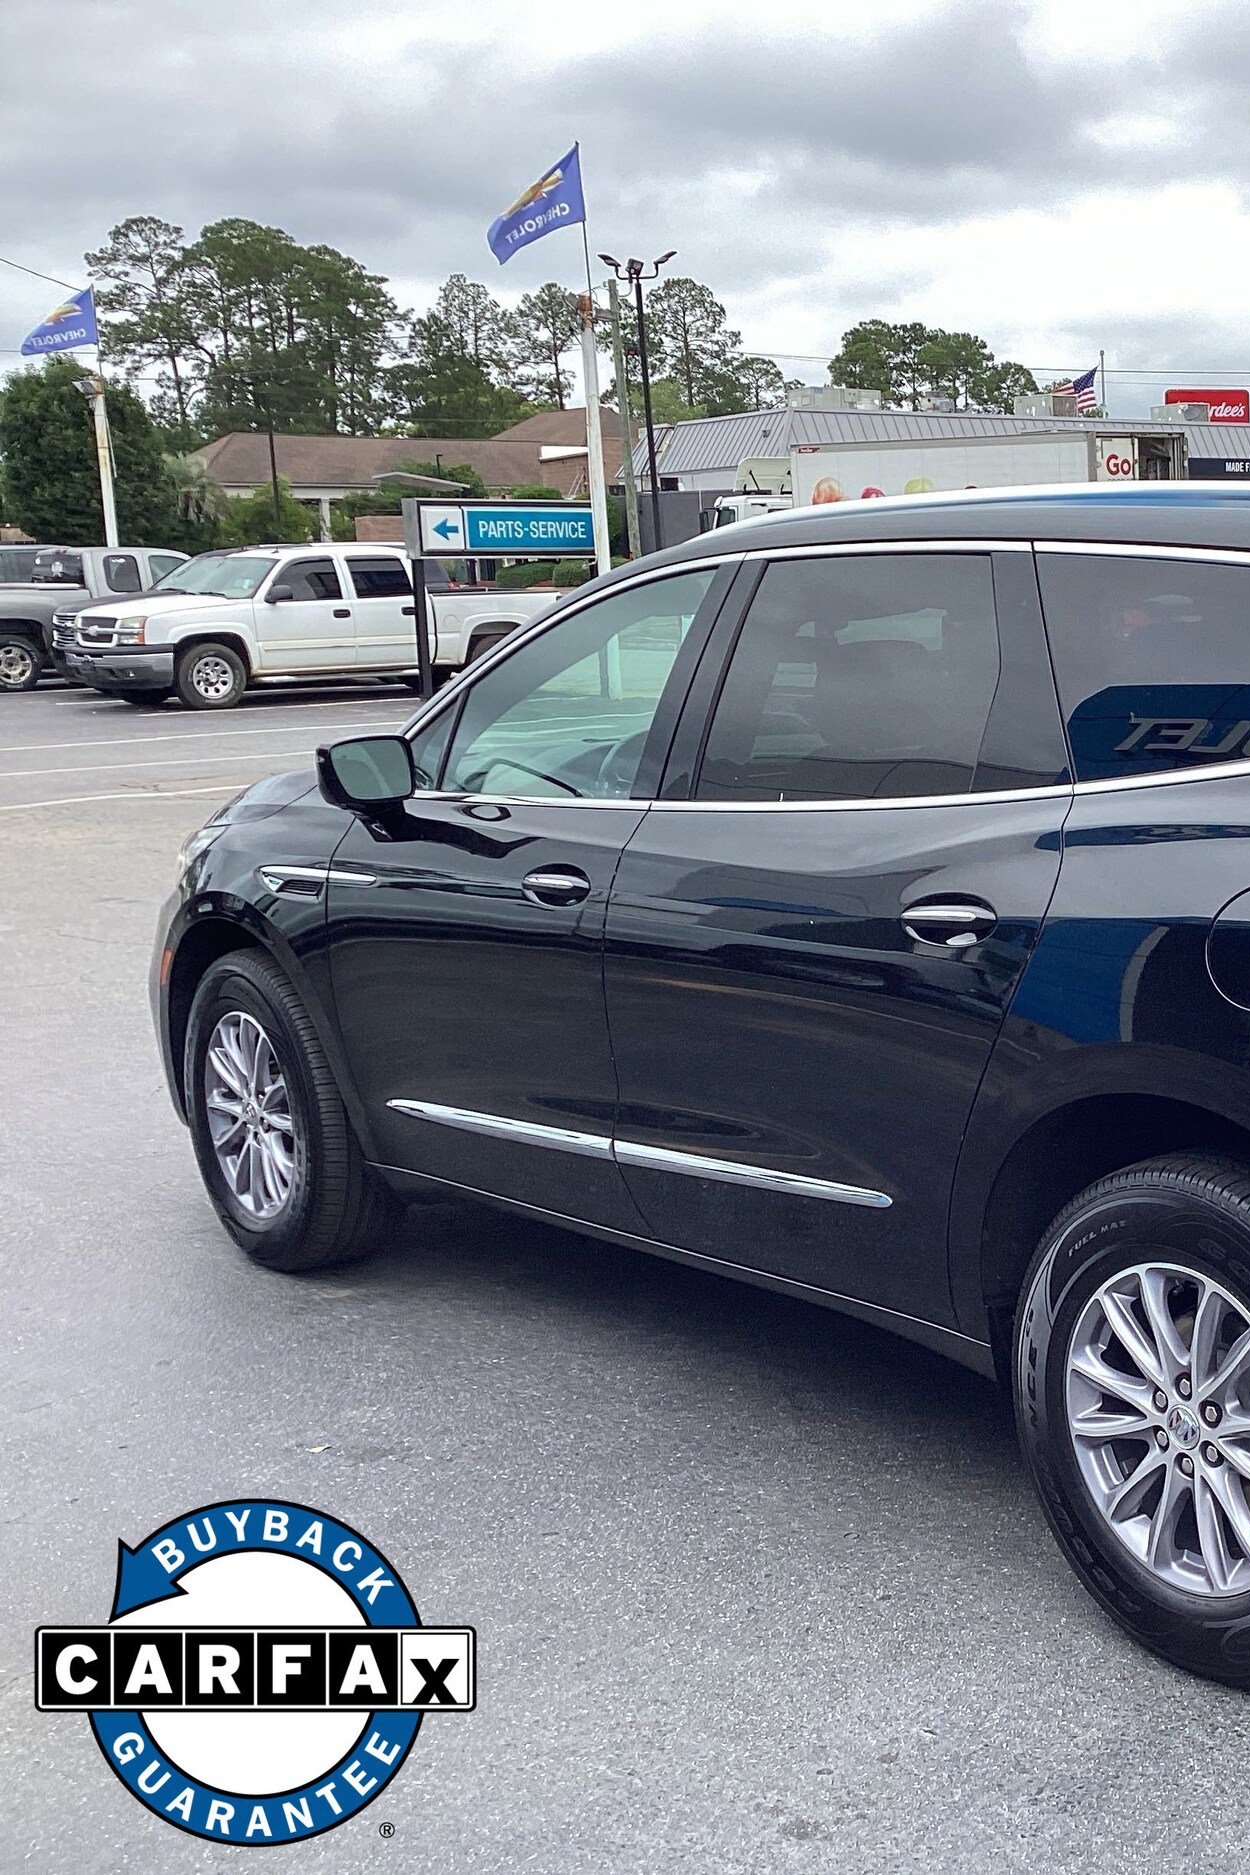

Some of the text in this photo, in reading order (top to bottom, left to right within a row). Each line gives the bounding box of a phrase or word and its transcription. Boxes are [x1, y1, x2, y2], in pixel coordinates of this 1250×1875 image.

[1209, 402, 1246, 418] rdee's
[1106, 454, 1138, 476] Go
[1225, 461, 1244, 472] MADE
[478, 520, 587, 538] PARTS-SERVICE
[1068, 1220, 1128, 1258] FUEL MAX
